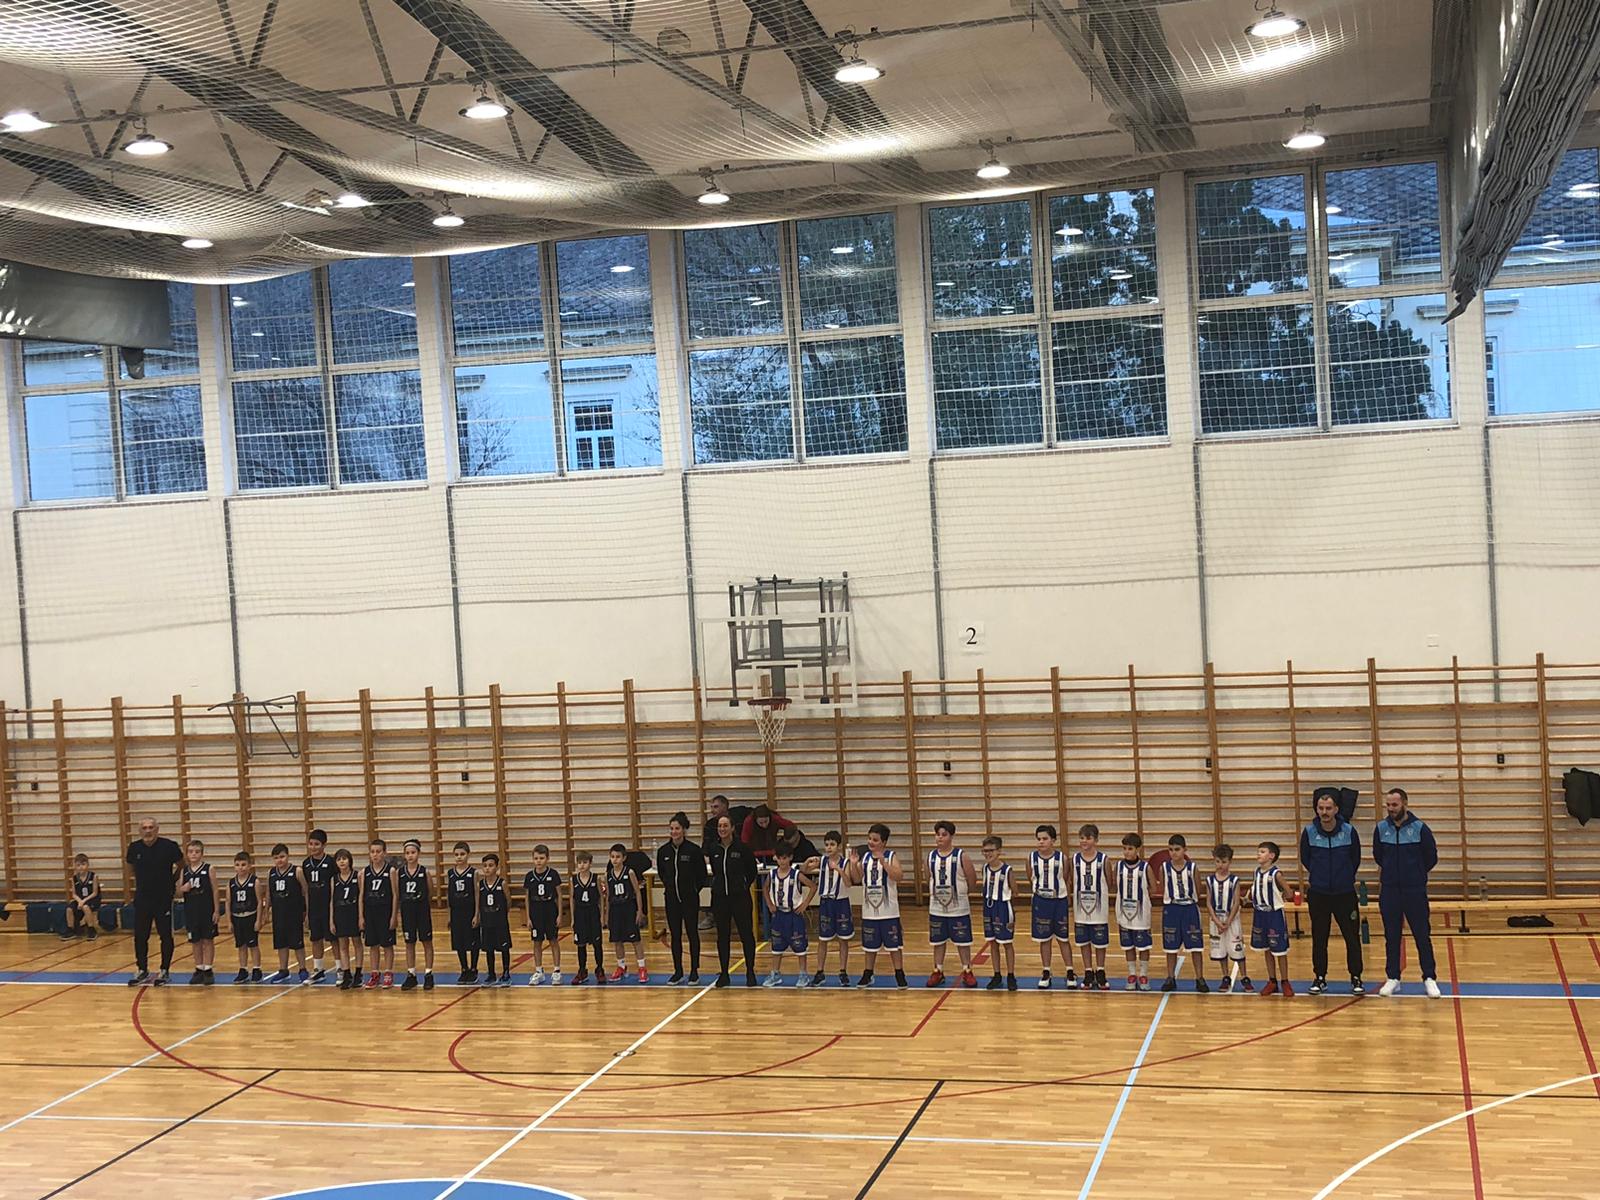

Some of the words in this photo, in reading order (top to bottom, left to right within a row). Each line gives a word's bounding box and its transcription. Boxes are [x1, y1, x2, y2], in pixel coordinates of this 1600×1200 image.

[966, 627, 977, 645] 2
[311, 871, 319, 881] 11
[189, 878, 201, 888] 14
[371, 879, 382, 890] 17
[406, 881, 416, 893] 12
[343, 887, 350, 899] 7
[538, 884, 545, 895] 8
[614, 883, 624, 895] 10
[236, 890, 246, 901] 13
[581, 891, 589, 902] 4
